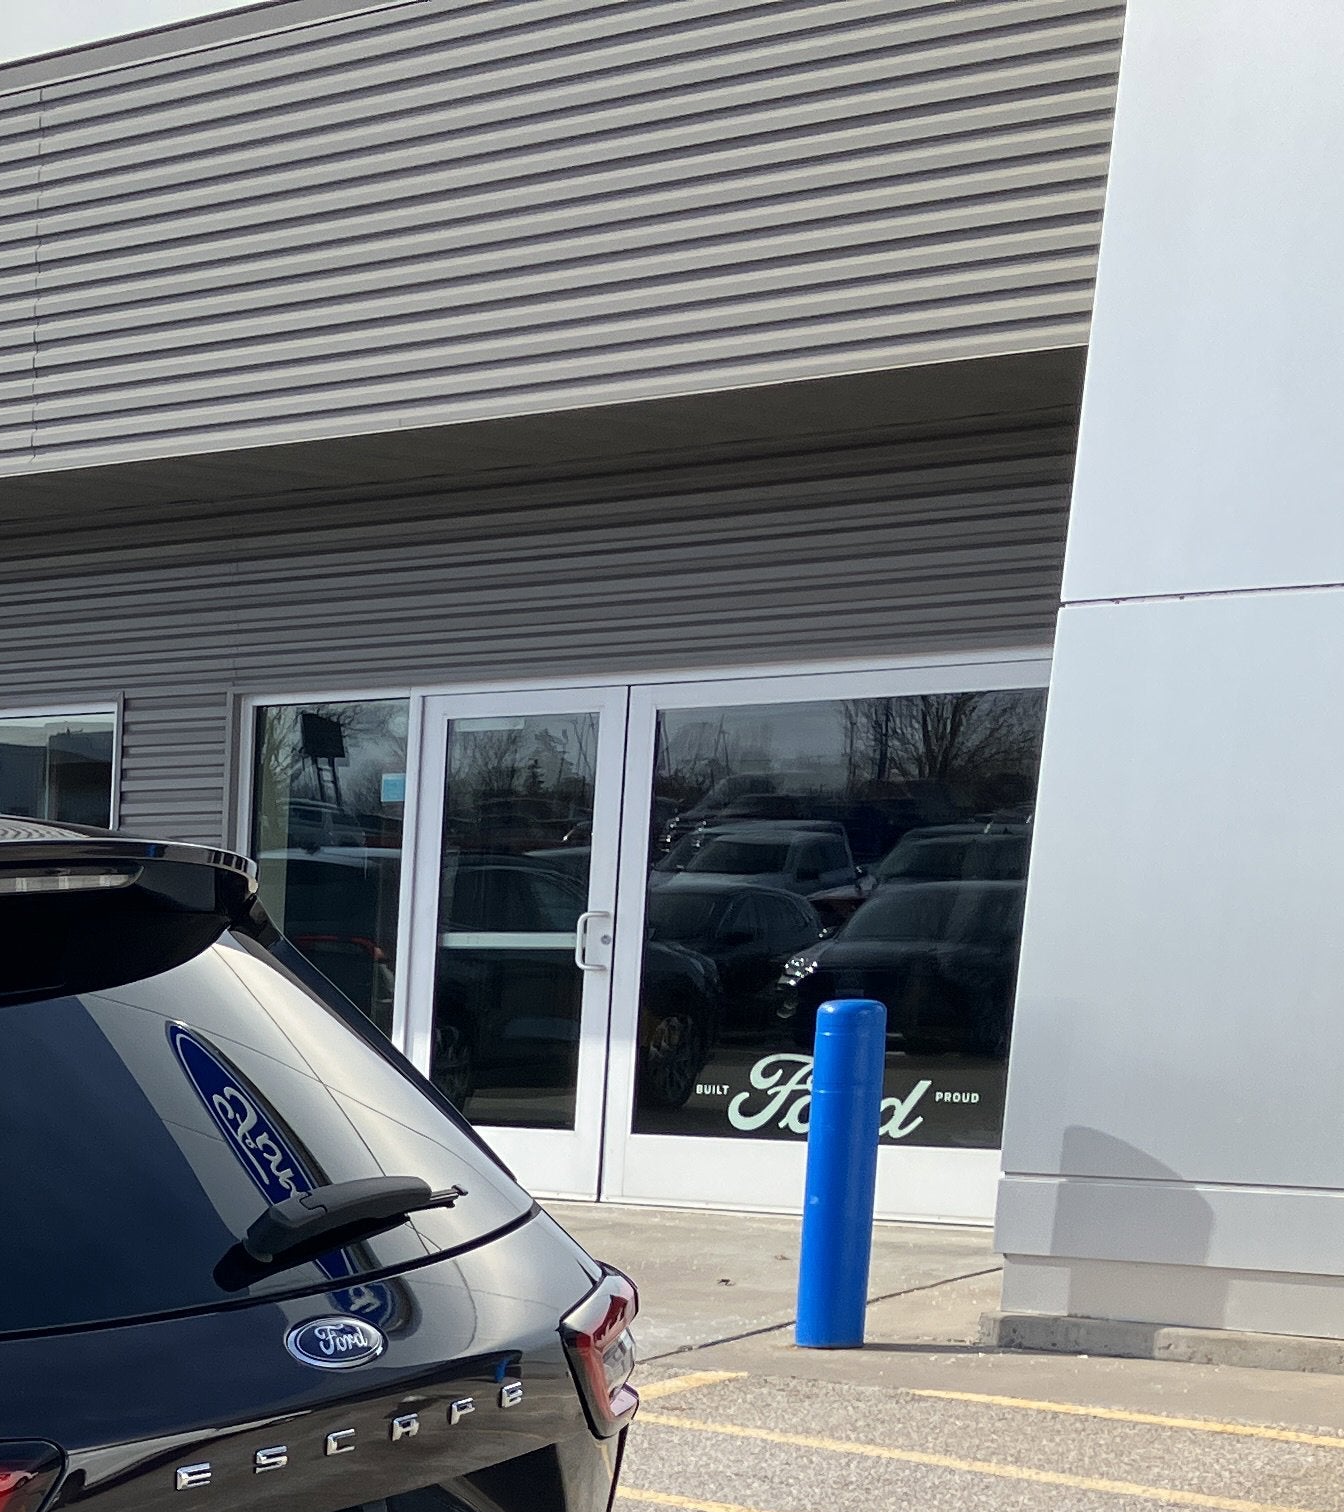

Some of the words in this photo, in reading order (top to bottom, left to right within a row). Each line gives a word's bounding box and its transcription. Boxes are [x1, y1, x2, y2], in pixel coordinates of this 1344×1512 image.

[696, 1084, 729, 1095] BUILT
[935, 1091, 980, 1104] PROUD
[314, 1323, 368, 1356] Ford
[175, 1381, 524, 1491] ESCAPE
